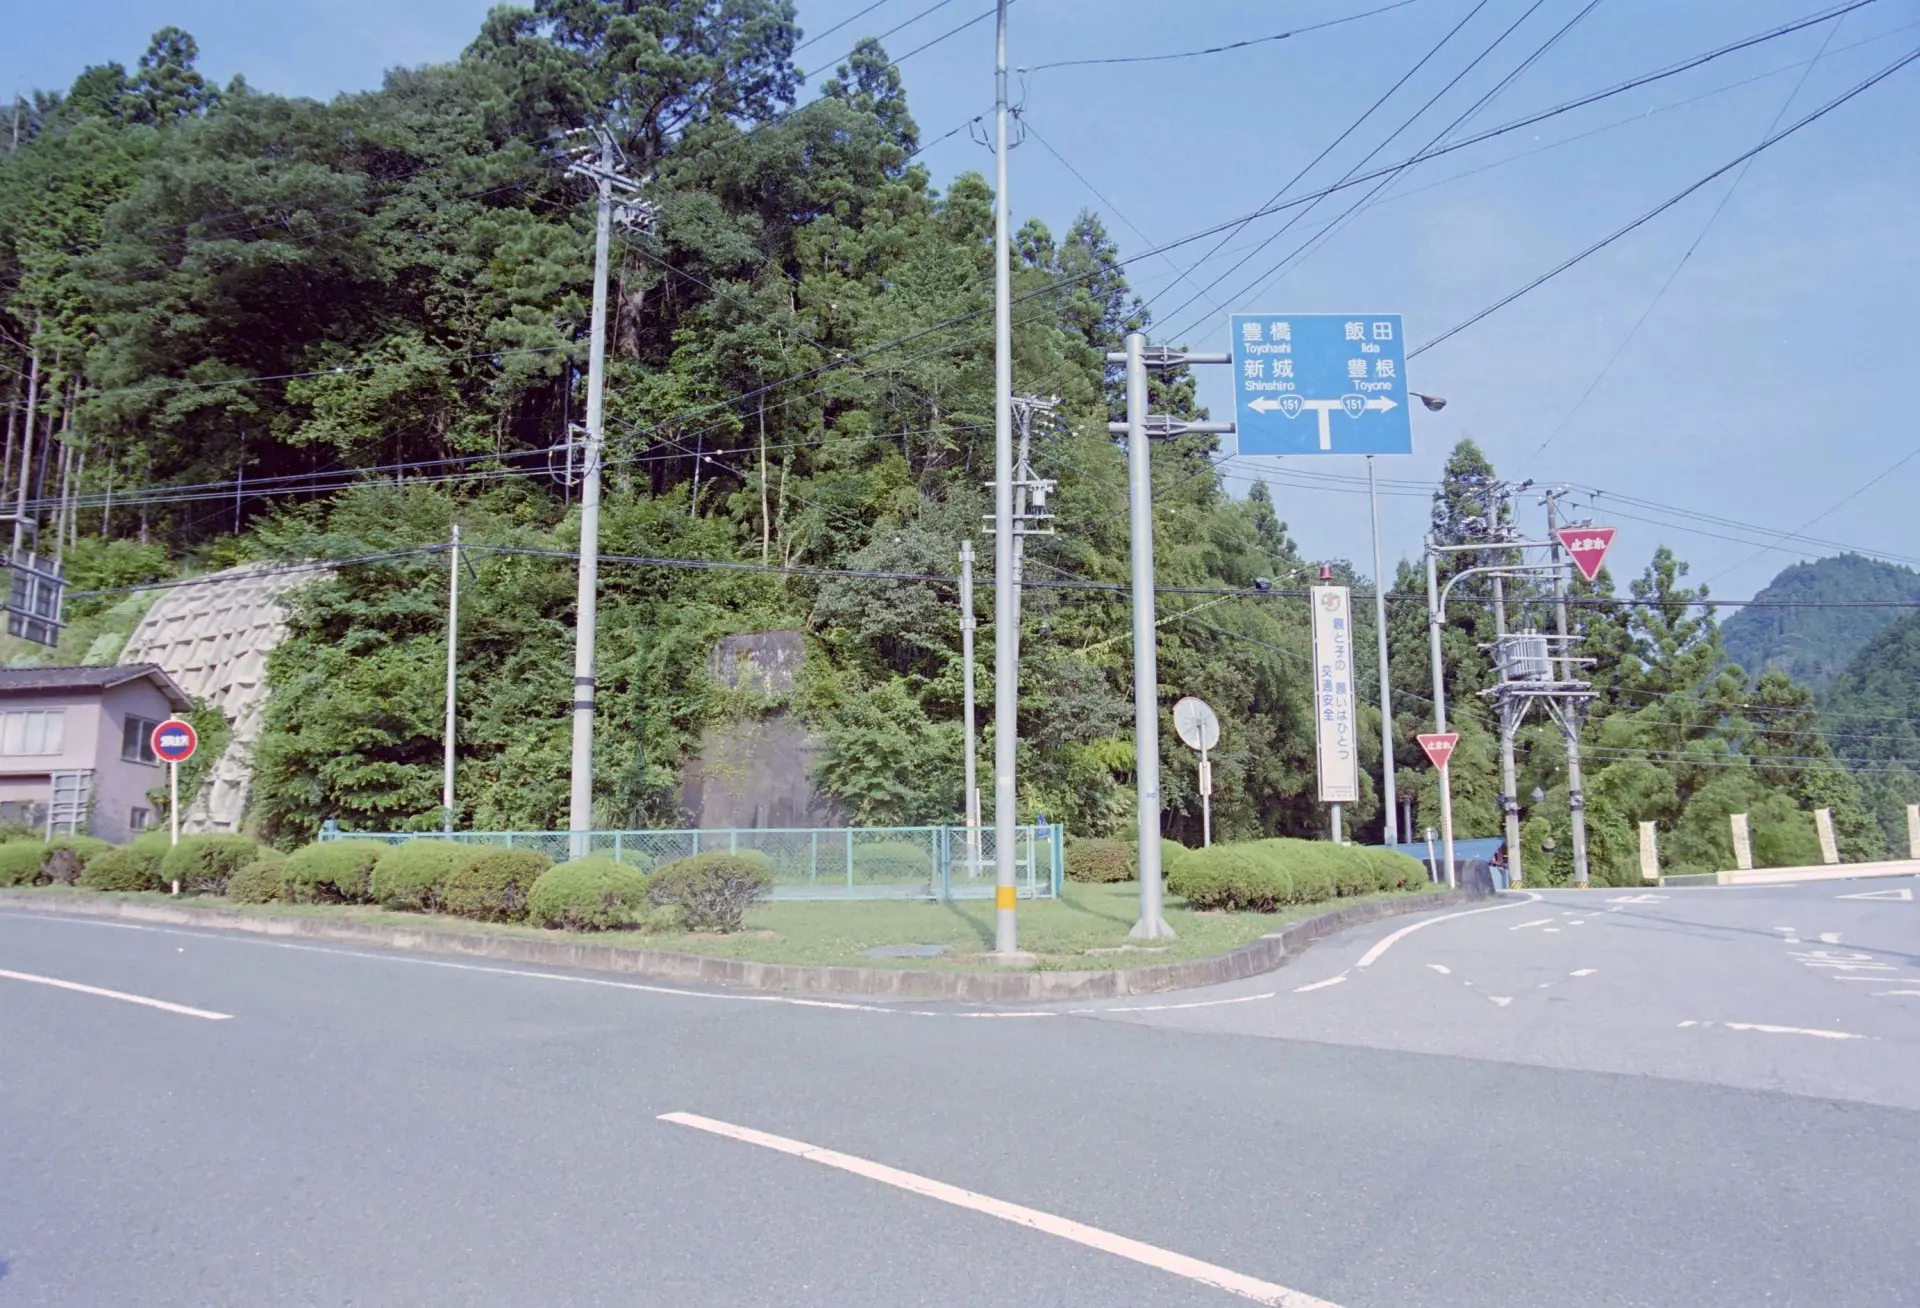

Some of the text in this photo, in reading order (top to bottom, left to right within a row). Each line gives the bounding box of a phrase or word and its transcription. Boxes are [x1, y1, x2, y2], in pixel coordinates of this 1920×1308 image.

[1242, 322, 1291, 341] 豊橋
[1344, 321, 1393, 340] 飯田
[1244, 343, 1291, 355] Toyohashi
[1361, 342, 1380, 353] Iida
[1244, 359, 1294, 378] 新城
[1347, 358, 1396, 378] 豊根
[1244, 380, 1295, 391] Shinshiro
[1353, 380, 1392, 392] Toyone
[1282, 400, 1299, 411] 151
[1345, 400, 1362, 411] 151
[1321, 665, 1334, 721] 交通安全
